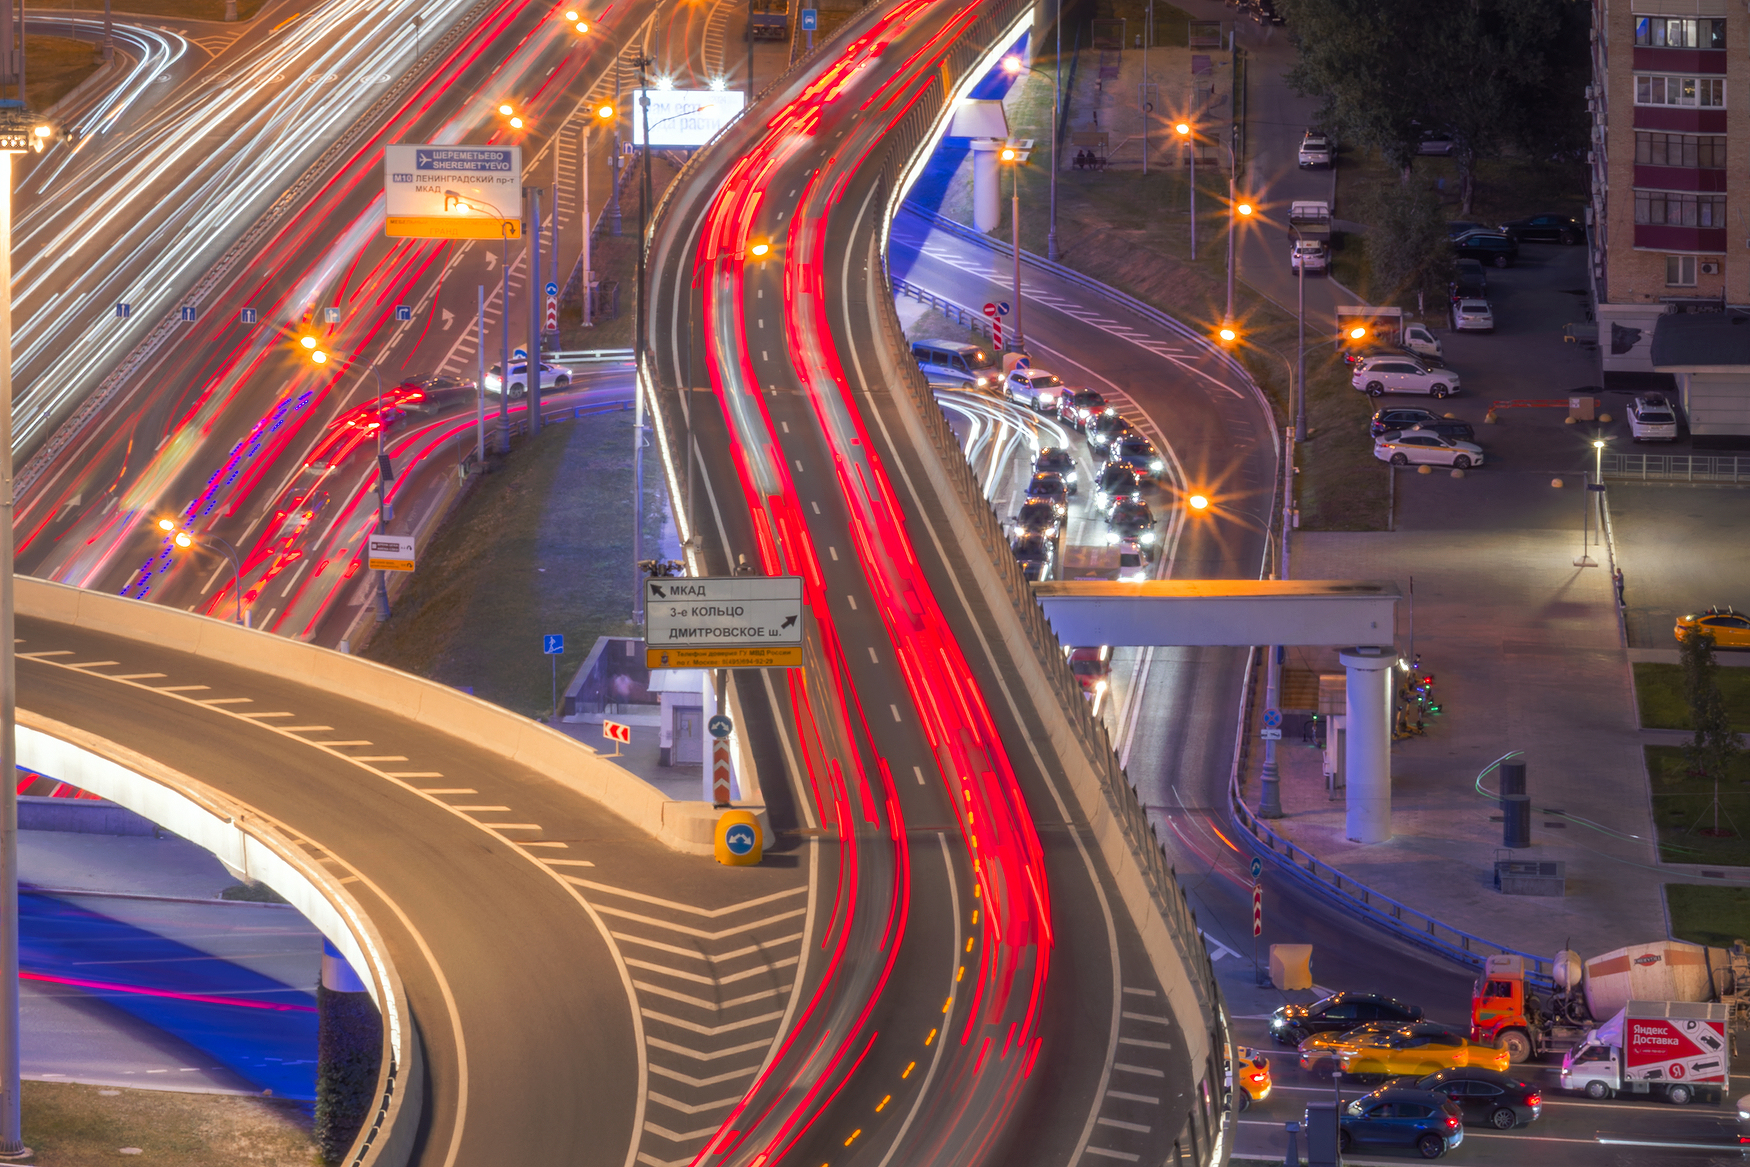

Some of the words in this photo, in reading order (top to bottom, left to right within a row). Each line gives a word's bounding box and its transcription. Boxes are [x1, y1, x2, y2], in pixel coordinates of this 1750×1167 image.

[433, 151, 504, 160] ШЕРЕМЕТЬЕВО
[433, 161, 510, 170] SHEREMET'YEVO
[416, 174, 494, 184] ЛЕНИНГРАДСКИЙ
[496, 177, 515, 185] пр-т
[415, 185, 441, 194] МКАД
[430, 228, 459, 236] ГРАНД
[670, 586, 706, 596] МКАД
[670, 608, 688, 617] 3-е
[691, 606, 744, 617] КОЛЬЦО
[669, 627, 765, 639] ДМИТРОВСКОЕ
[768, 629, 782, 637] ш.
[1633, 1024, 1668, 1035] Яндекс
[1633, 1034, 1679, 1045] Доставка
